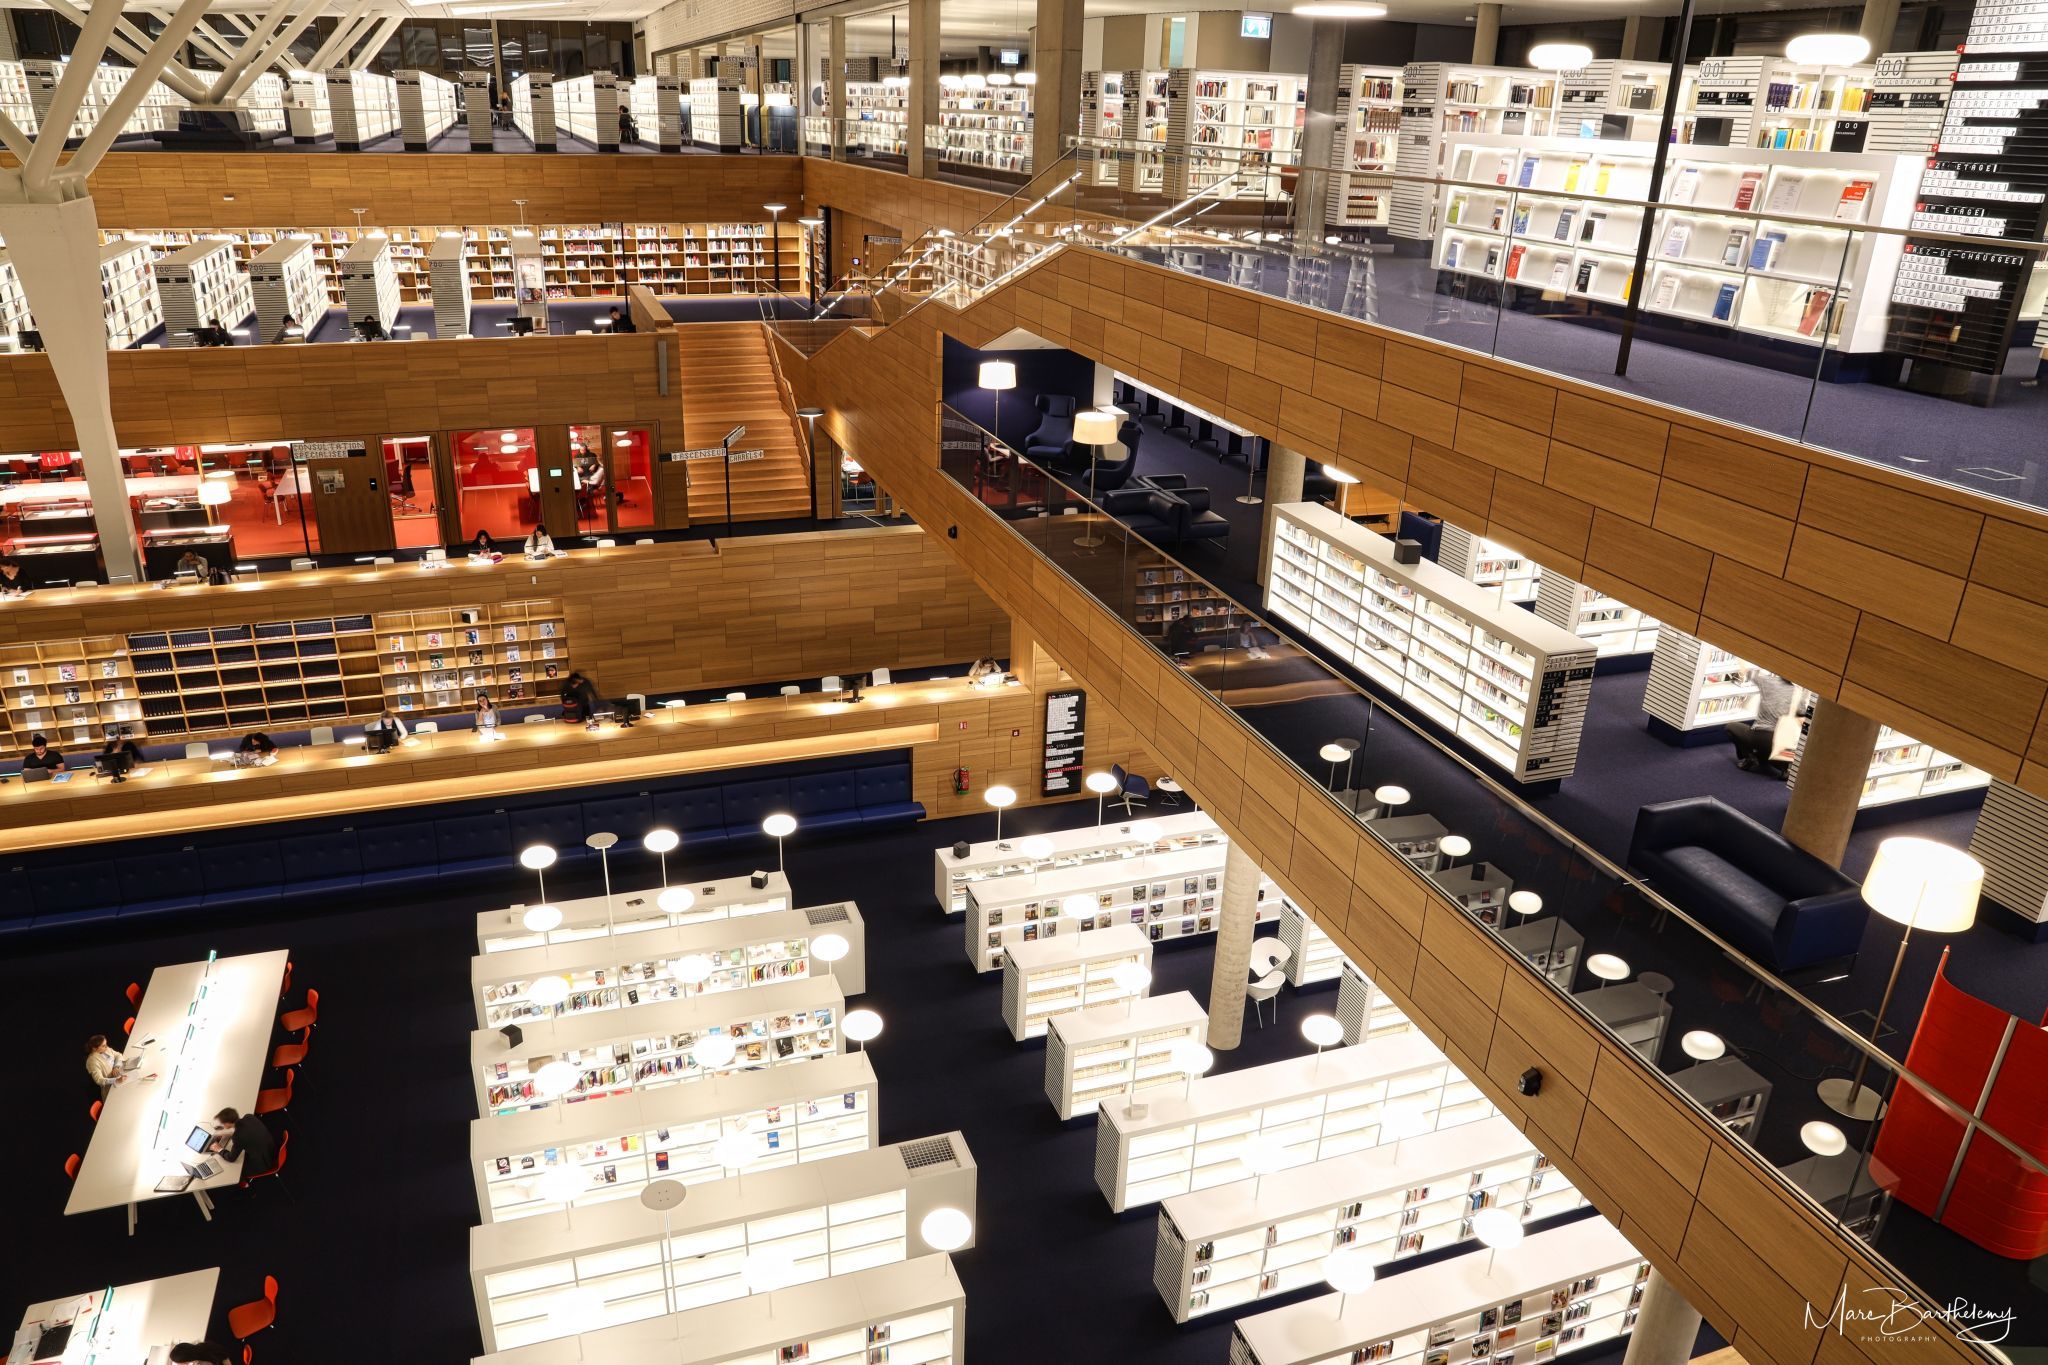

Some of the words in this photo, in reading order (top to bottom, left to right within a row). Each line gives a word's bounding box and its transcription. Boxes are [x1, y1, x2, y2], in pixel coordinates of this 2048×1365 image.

[1975, 5, 2037, 15] SCIENCES
[1972, 17, 2009, 25] LIVRE
[1969, 24, 2032, 34] HISTOIRE
[1967, 34, 2047, 43] GEOGRAPHIE
[1699, 62, 1720, 78] 100
[1875, 59, 1902, 77] 100
[1960, 63, 2012, 71] CARRELS
[1953, 91, 1988, 99] SALLE
[1948, 109, 2014, 117] ASCENSEUR
[1941, 136, 1998, 144] COPIEURS
[1956, 163, 1991, 172] ETAGE
[1926, 170, 1951, 178] ARTS
[1923, 179, 2002, 190] MEDIATHEQUE
[1921, 187, 1954, 196] SALLE
[1964, 190, 1976, 198] DE
[1986, 191, 2038, 203] MUSIQUE
[1944, 207, 1980, 216] ETAGE
[1914, 213, 2000, 227] CONSULTATION
[1912, 221, 1989, 235] SPECIALISEE
[1903, 255, 1942, 264] REVUES
[1912, 247, 2018, 265] REZ-DE-CHAUSSEE
[1901, 263, 1942, 273] PRESSE
[1899, 271, 1967, 285] NOUVEAUTES
[1895, 287, 1933, 298] ESPACE
[1897, 279, 1995, 298] LUXEMBURGENSIA
[1893, 295, 1960, 311] DECOUVERTE
[294, 442, 365, 452] CONSULTATION
[680, 448, 726, 460] ASCENSEUR
[729, 451, 759, 462] CARRELS
